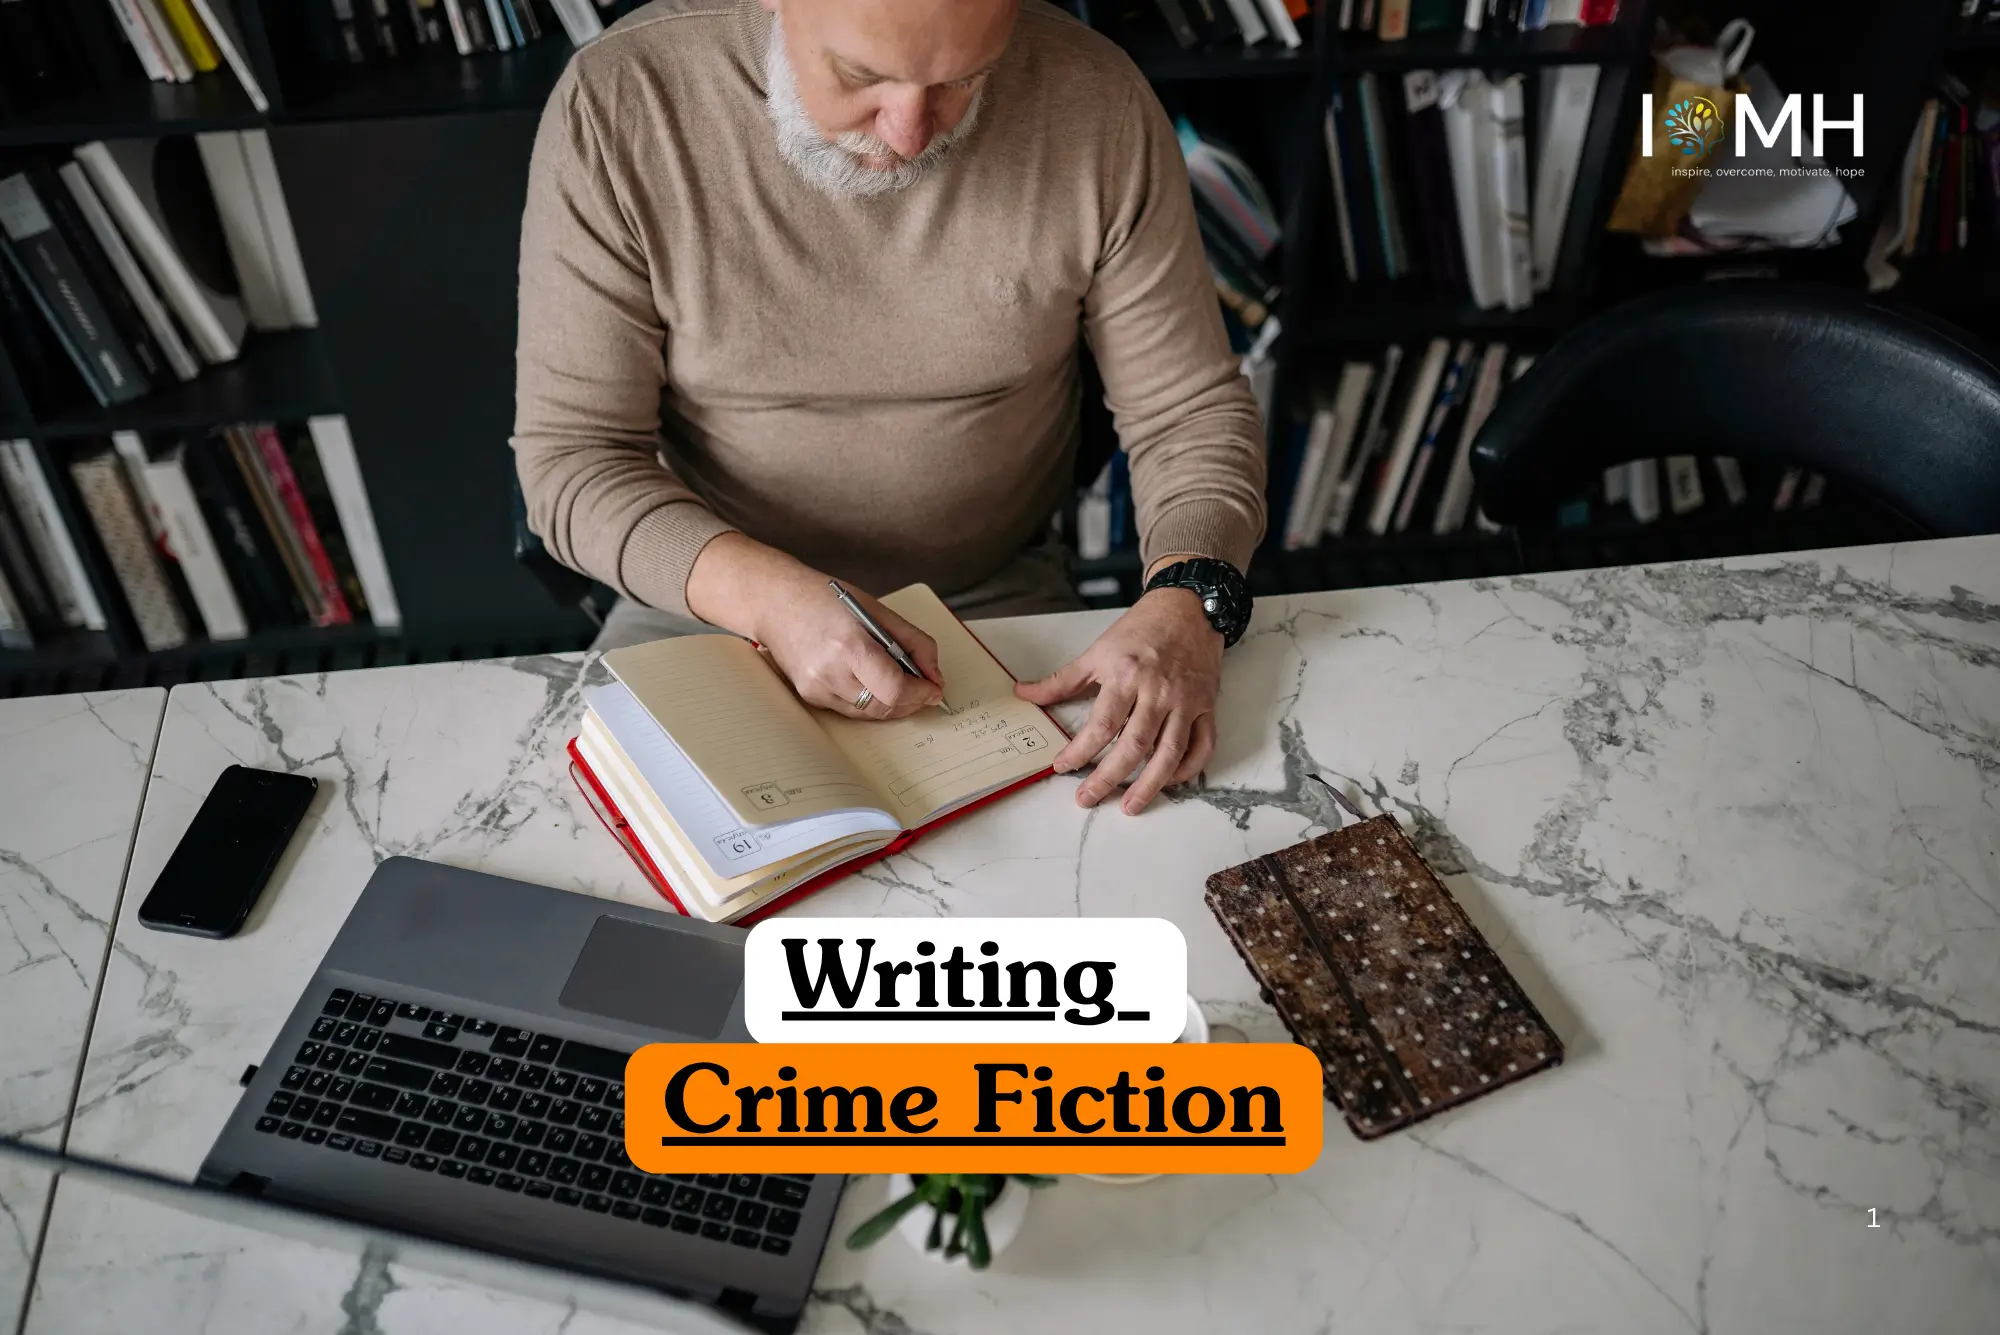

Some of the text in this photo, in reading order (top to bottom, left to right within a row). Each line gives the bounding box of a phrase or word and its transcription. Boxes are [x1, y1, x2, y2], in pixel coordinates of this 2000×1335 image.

[1022, 737, 1036, 748] 2
[761, 793, 774, 805] 3
[732, 839, 752, 854] 19
